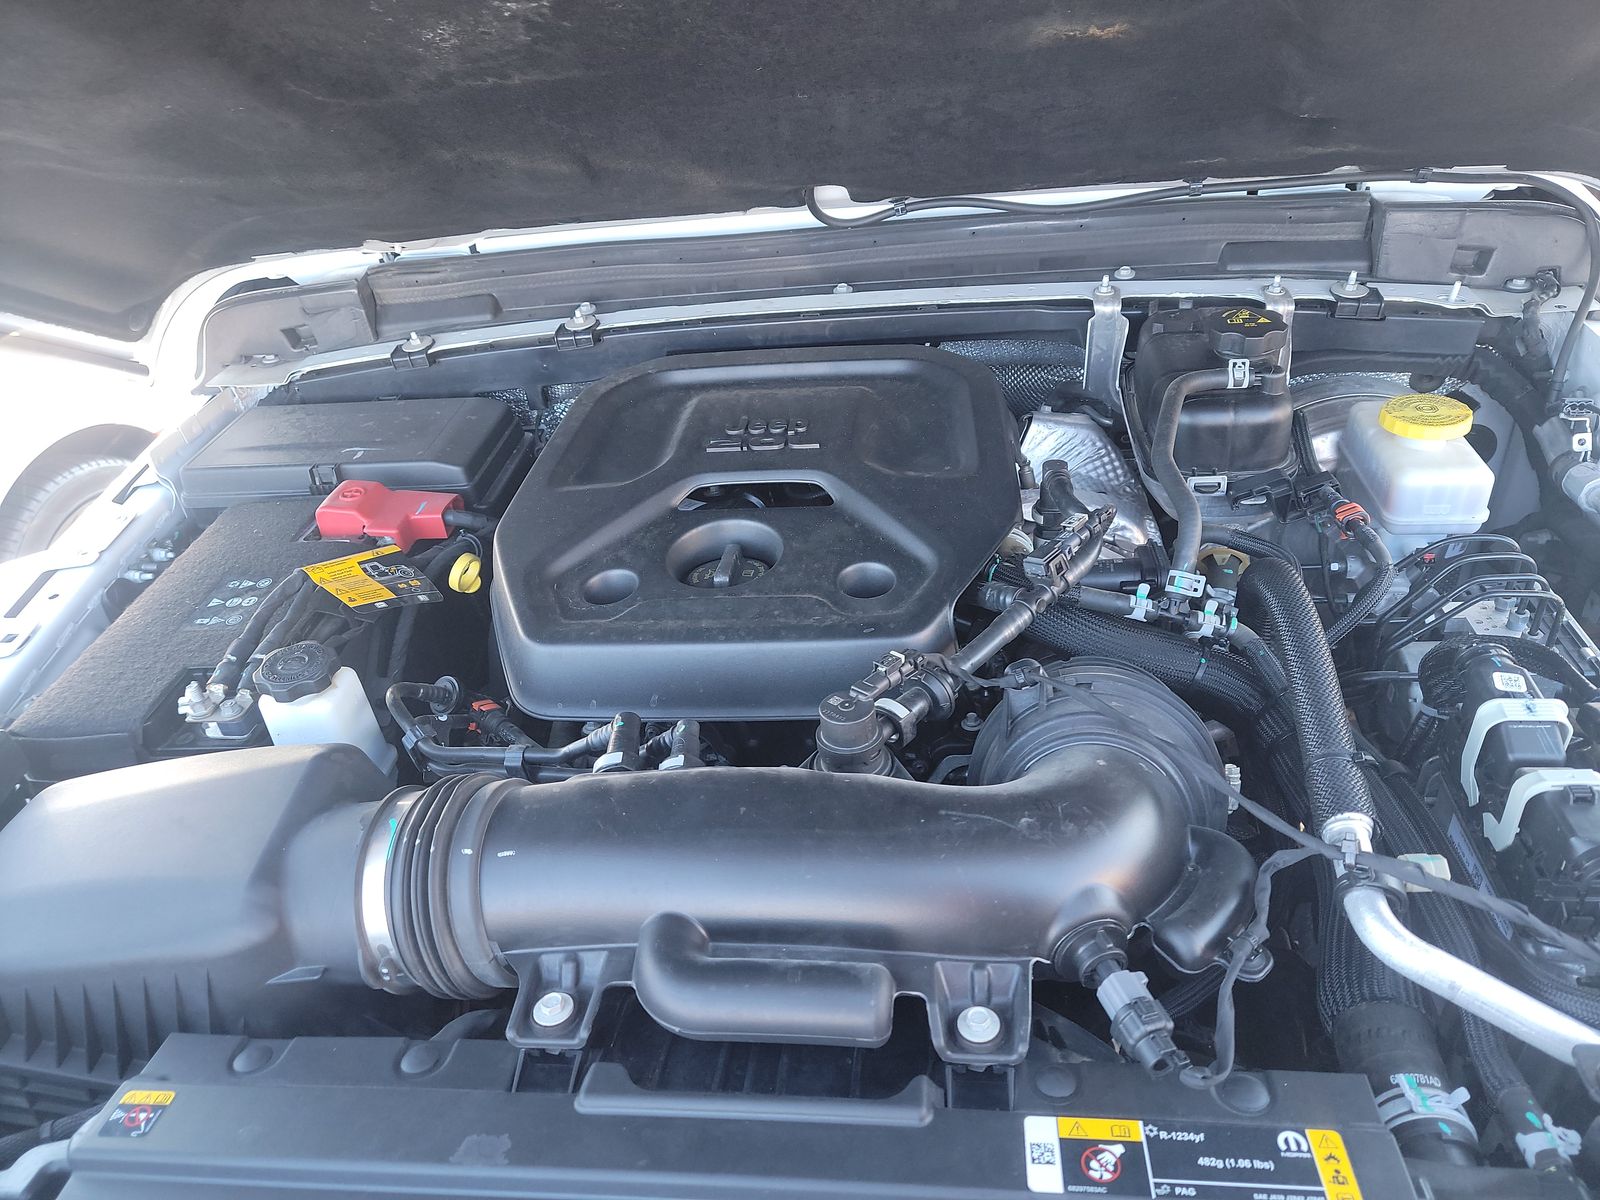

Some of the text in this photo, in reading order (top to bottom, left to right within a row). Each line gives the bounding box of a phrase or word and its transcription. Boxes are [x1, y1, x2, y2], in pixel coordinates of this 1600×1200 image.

[724, 415, 809, 436] Jeep
[706, 436, 820, 453] 2.0L
[1253, 1158, 1275, 1172] lbs)
[1174, 1186, 1197, 1197] PAG
